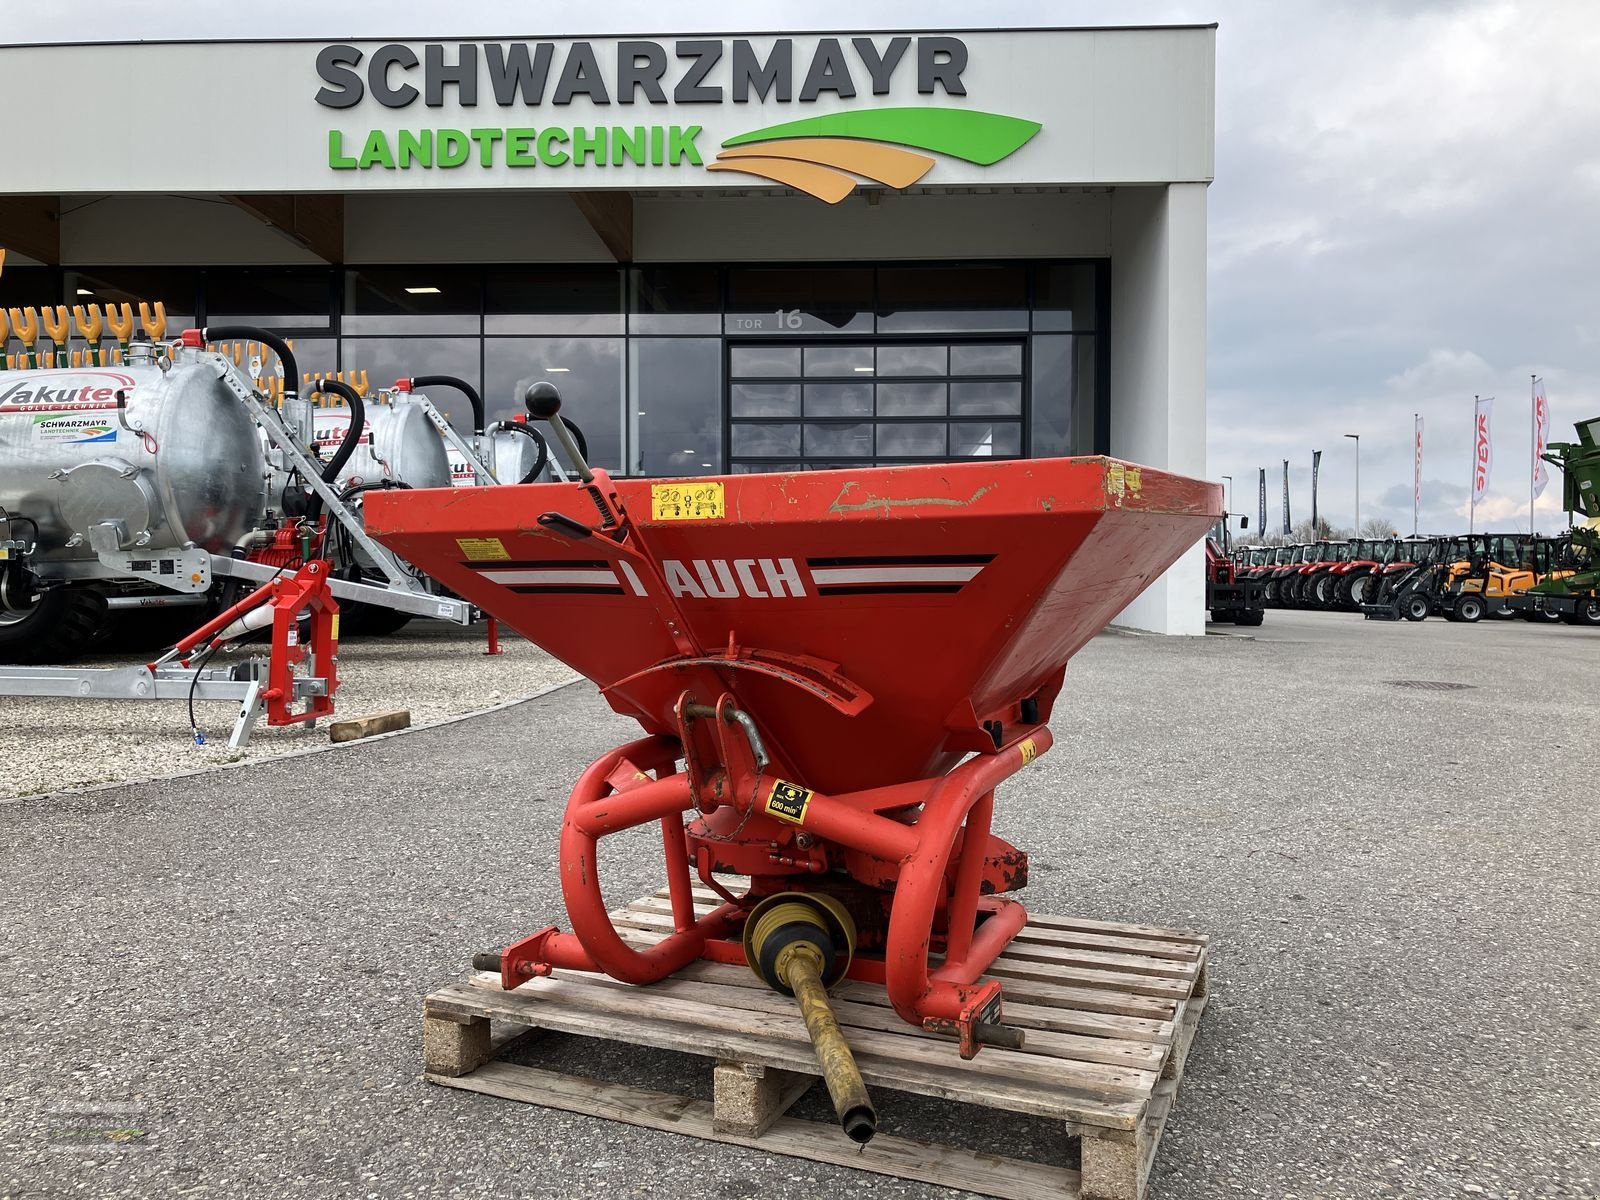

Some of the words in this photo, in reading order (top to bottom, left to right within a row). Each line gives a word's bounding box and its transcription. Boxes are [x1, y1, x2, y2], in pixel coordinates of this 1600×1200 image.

[314, 37, 968, 107] SCHWARZMAYR
[329, 125, 704, 170] LANDTECHNIK
[736, 319, 762, 329] TOR
[775, 308, 803, 329] 16
[40, 419, 107, 428] SCHWARZMAYR
[1475, 413, 1489, 492] STEYR
[772, 800, 783, 810] 600
